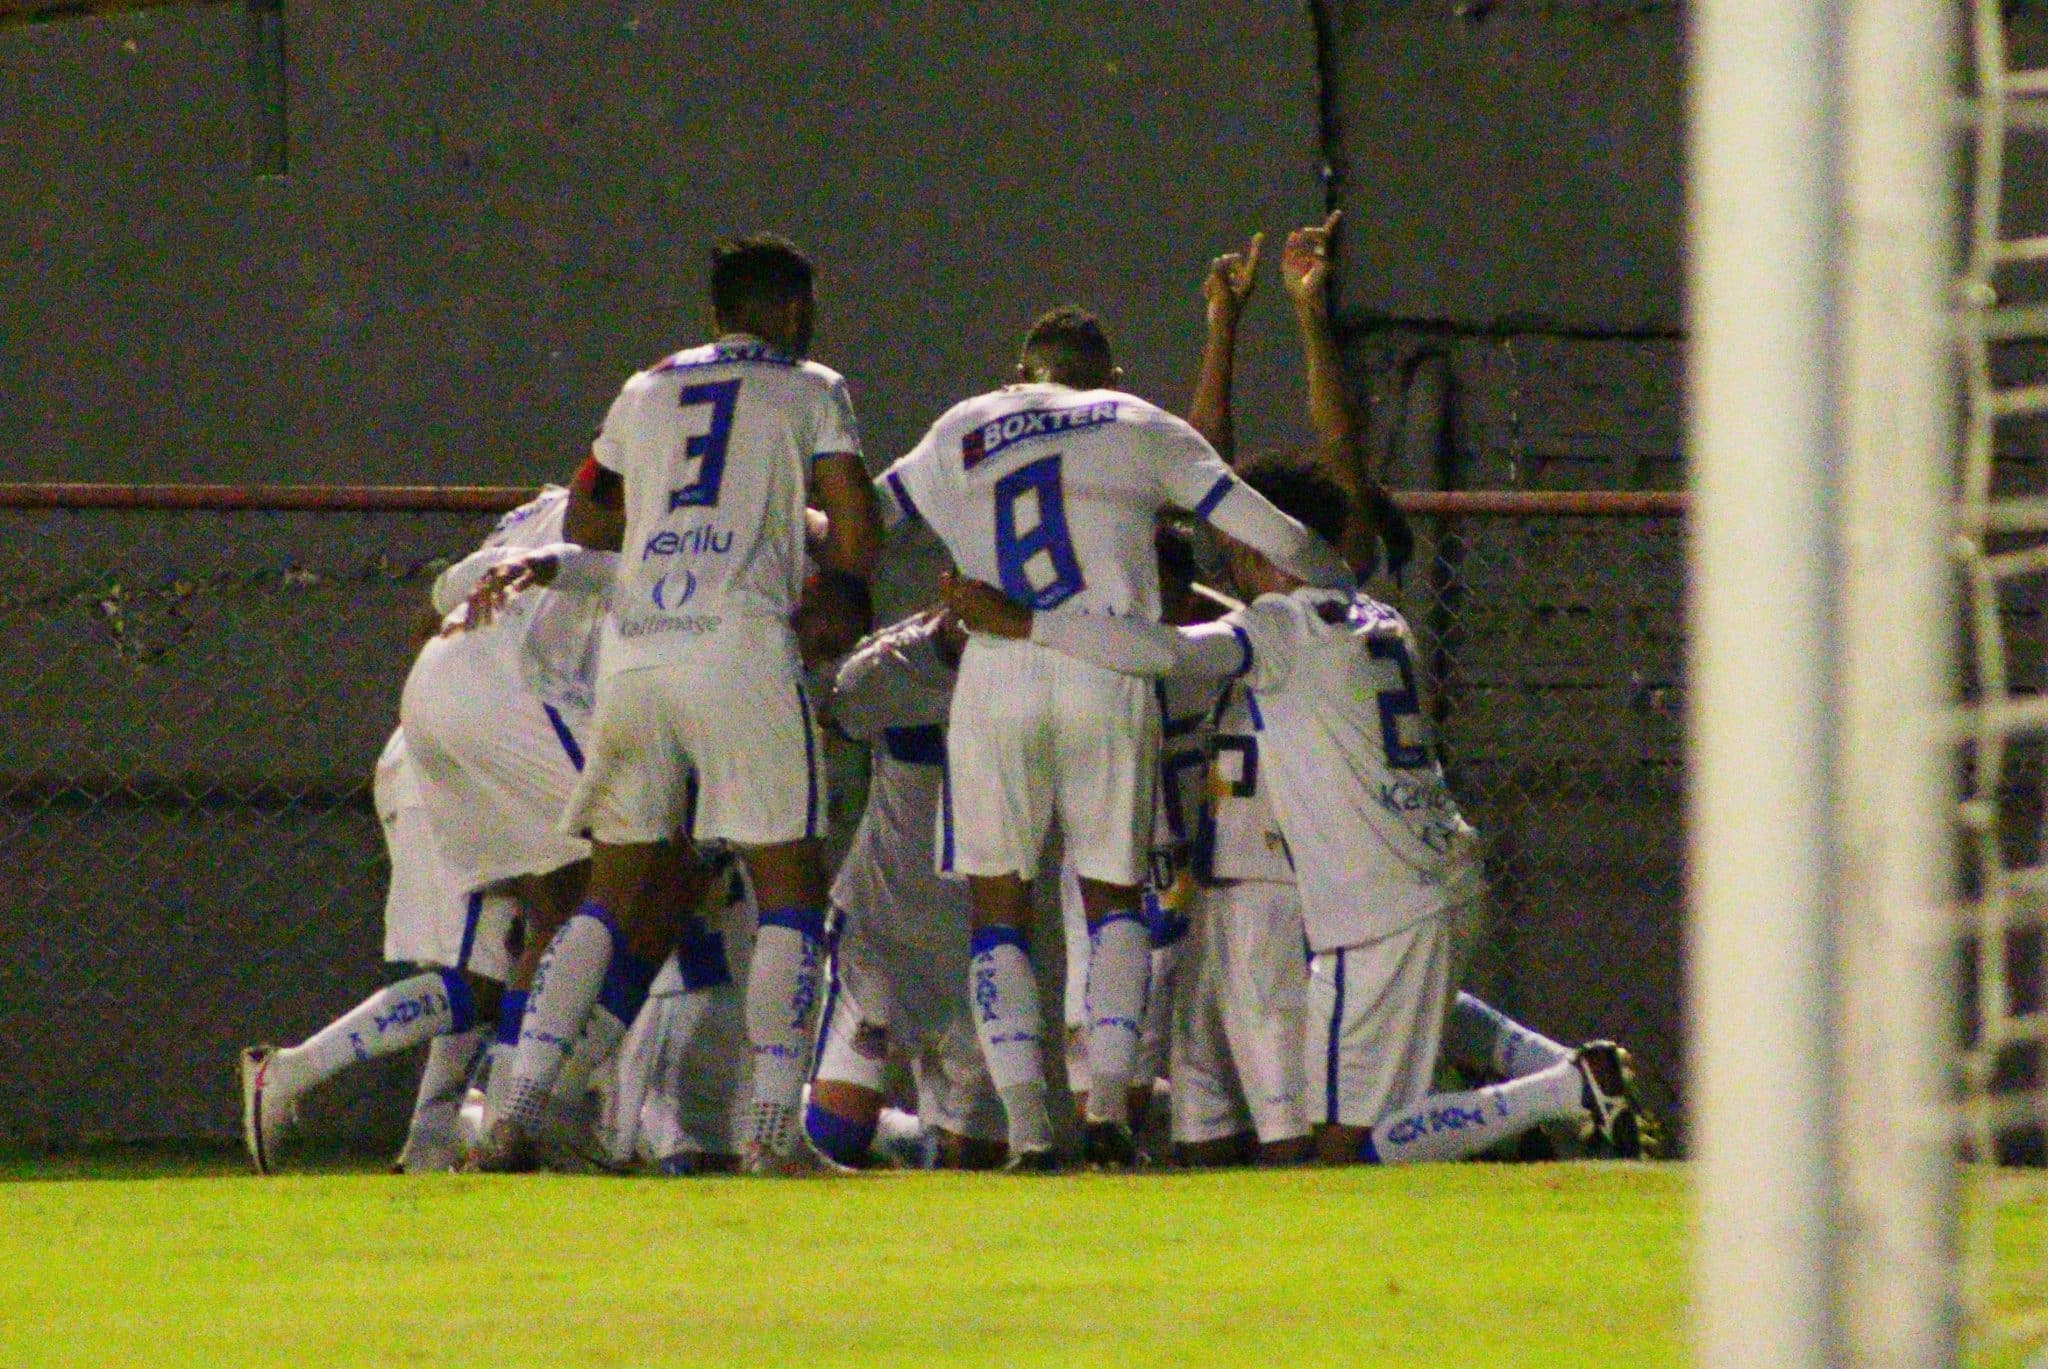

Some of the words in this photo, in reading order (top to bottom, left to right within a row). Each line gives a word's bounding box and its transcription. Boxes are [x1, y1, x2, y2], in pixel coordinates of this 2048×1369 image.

[667, 378, 743, 514] 3
[983, 401, 1118, 450] BOXTER
[994, 454, 1086, 611] 8
[1366, 634, 1427, 768] 2
